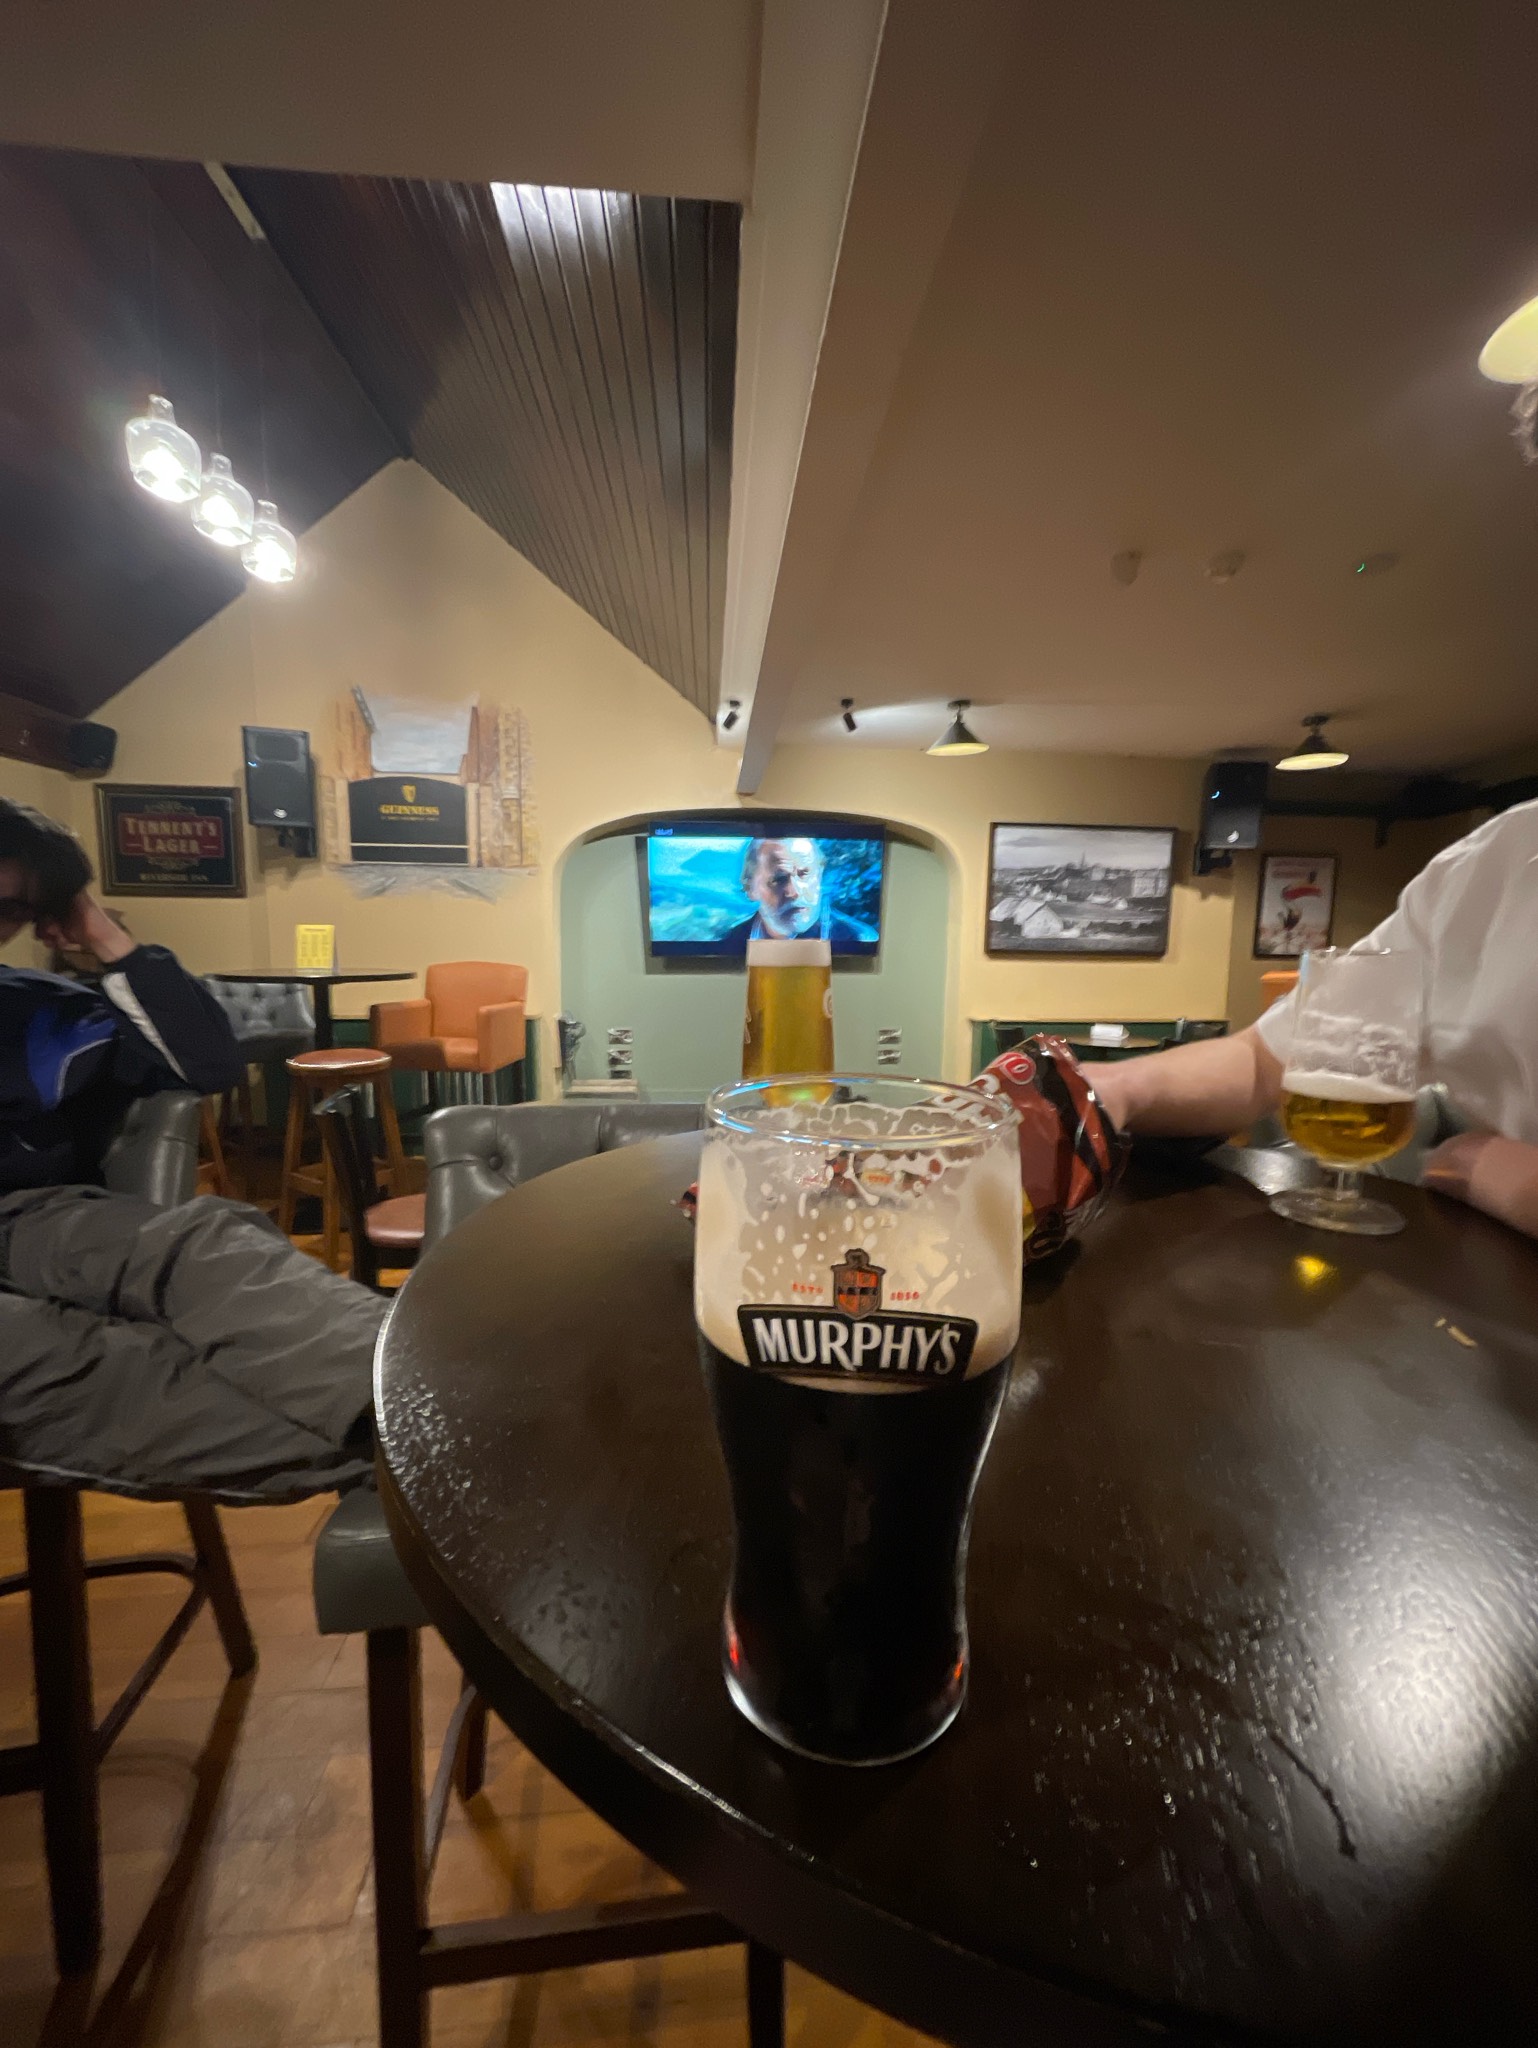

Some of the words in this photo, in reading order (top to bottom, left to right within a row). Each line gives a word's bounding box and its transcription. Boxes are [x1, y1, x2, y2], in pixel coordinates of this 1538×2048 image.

[379, 804, 440, 815] GUINNESS
[125, 817, 217, 837] TENNENT'S
[143, 834, 200, 853] LAGER
[752, 1317, 961, 1375] MURPHY'S
